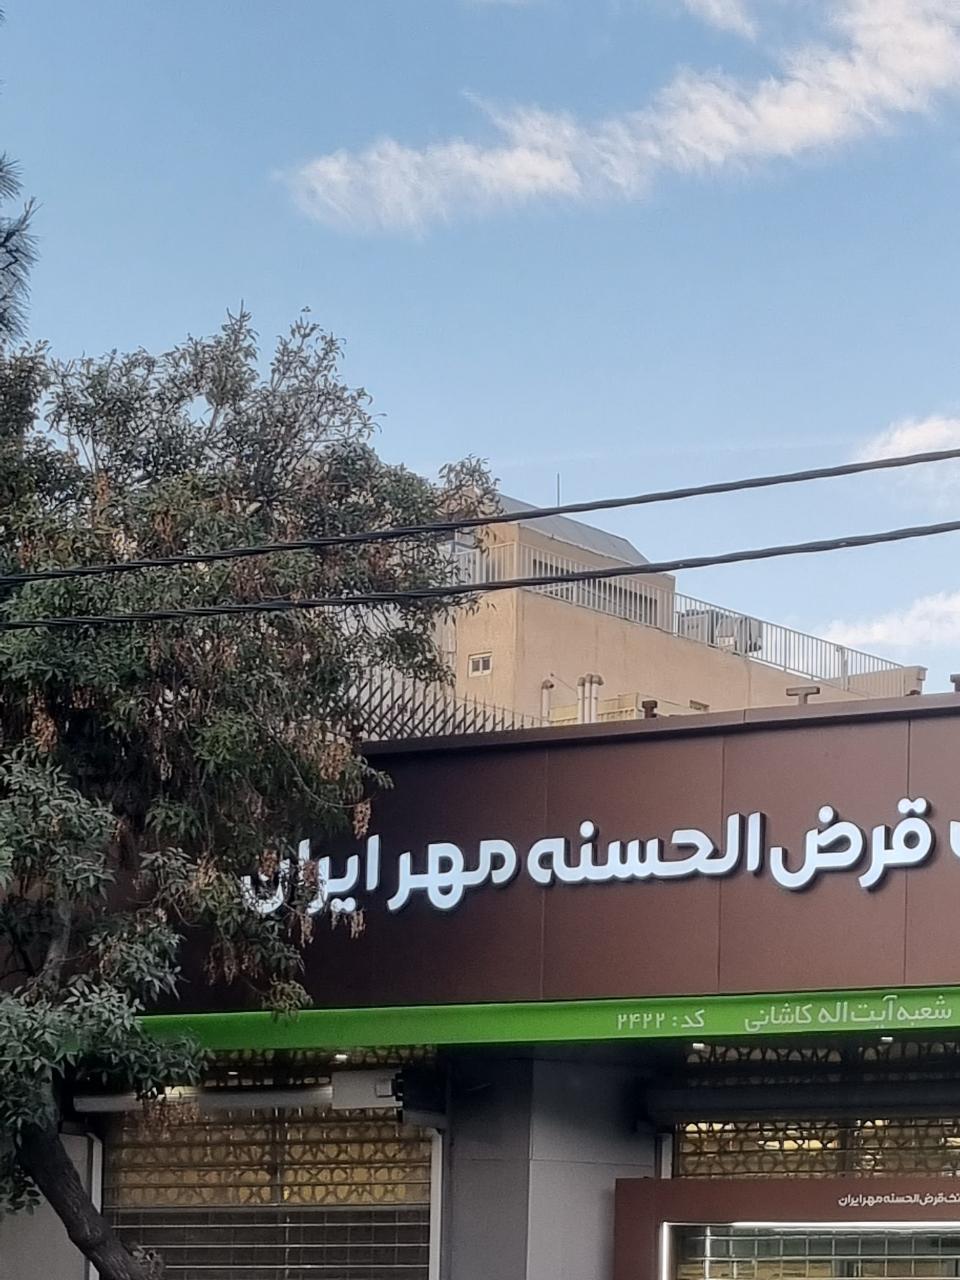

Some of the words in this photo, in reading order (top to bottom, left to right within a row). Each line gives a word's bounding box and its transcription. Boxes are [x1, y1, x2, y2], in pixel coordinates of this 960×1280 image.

[527, 811, 762, 885] الحسنه
[769, 797, 933, 888] قرض
[387, 838, 518, 911] مهر
[617, 1012, 666, 1031] ۲۴۲۲
[744, 1003, 813, 1033] کاشانی
[817, 1001, 848, 1023] اله
[850, 994, 897, 1029] آیت
[897, 995, 952, 1026] شعبه
[838, 1193, 862, 1207] ایران
[862, 1194, 884, 1207] مهر
[884, 1192, 920, 1206] الحسنه
[919, 1192, 945, 1207] قرض
